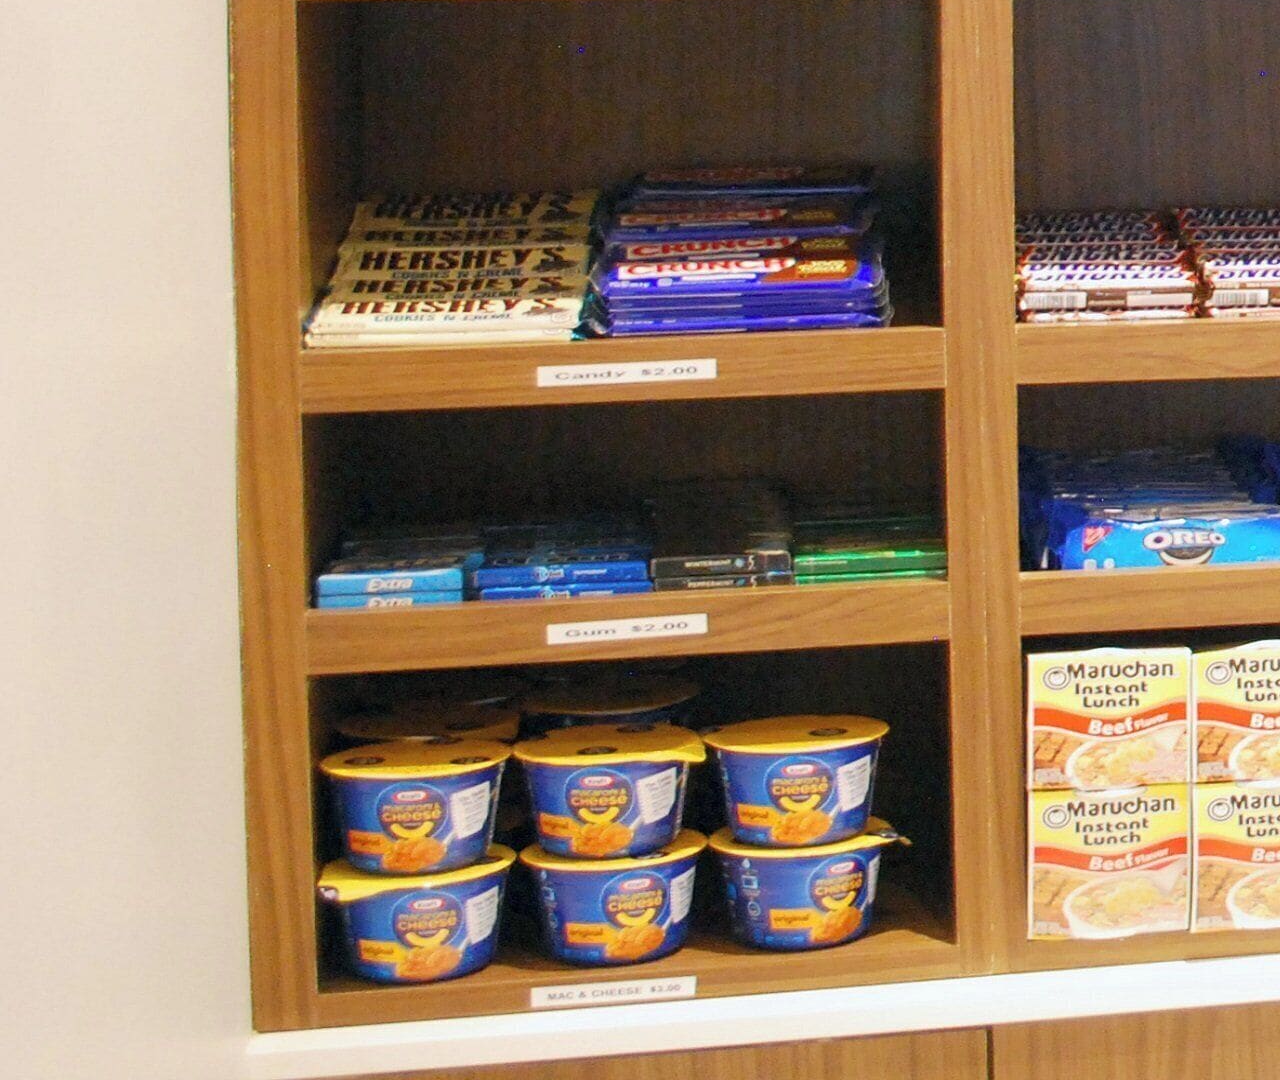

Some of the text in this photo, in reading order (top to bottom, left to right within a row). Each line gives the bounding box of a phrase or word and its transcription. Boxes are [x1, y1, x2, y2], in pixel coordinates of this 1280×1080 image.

[632, 237, 792, 257] CRUNCH
[625, 258, 789, 276] CRUNCH
[554, 365, 698, 381] Candy $2.00
[1143, 528, 1226, 550] OREO
[564, 621, 690, 638] Gum $2.00
[1067, 660, 1174, 680] Maruchan
[1074, 681, 1148, 695] Instant
[1083, 694, 1141, 708] Lunch
[1087, 716, 1134, 736] Beef
[1067, 797, 1175, 817] Maruchan
[1088, 851, 1134, 871] Beef
[546, 991, 575, 1001] MAC
[591, 986, 643, 999] CHEESE
